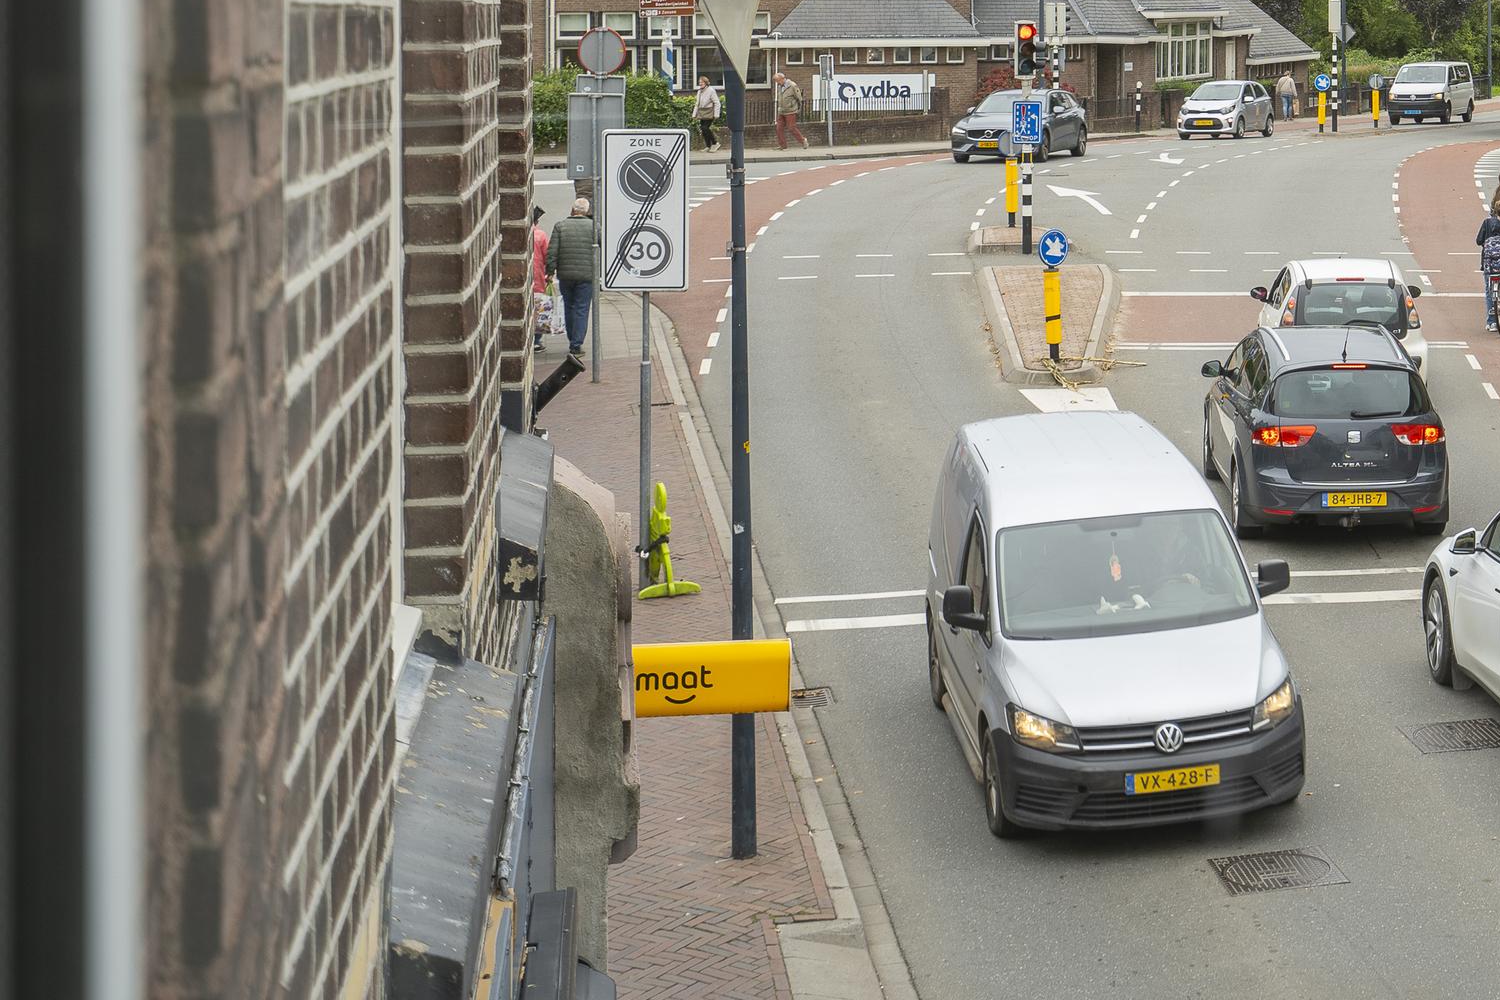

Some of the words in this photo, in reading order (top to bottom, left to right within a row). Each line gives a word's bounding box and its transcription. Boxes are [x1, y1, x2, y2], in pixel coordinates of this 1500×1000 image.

[860, 80, 911, 99] vdba
[629, 138, 662, 147] ZONE
[629, 241, 663, 260] 30
[1331, 494, 1383, 506] 84-JHB-7
[635, 665, 714, 692] maat
[1140, 767, 1214, 790] VX-428-F
